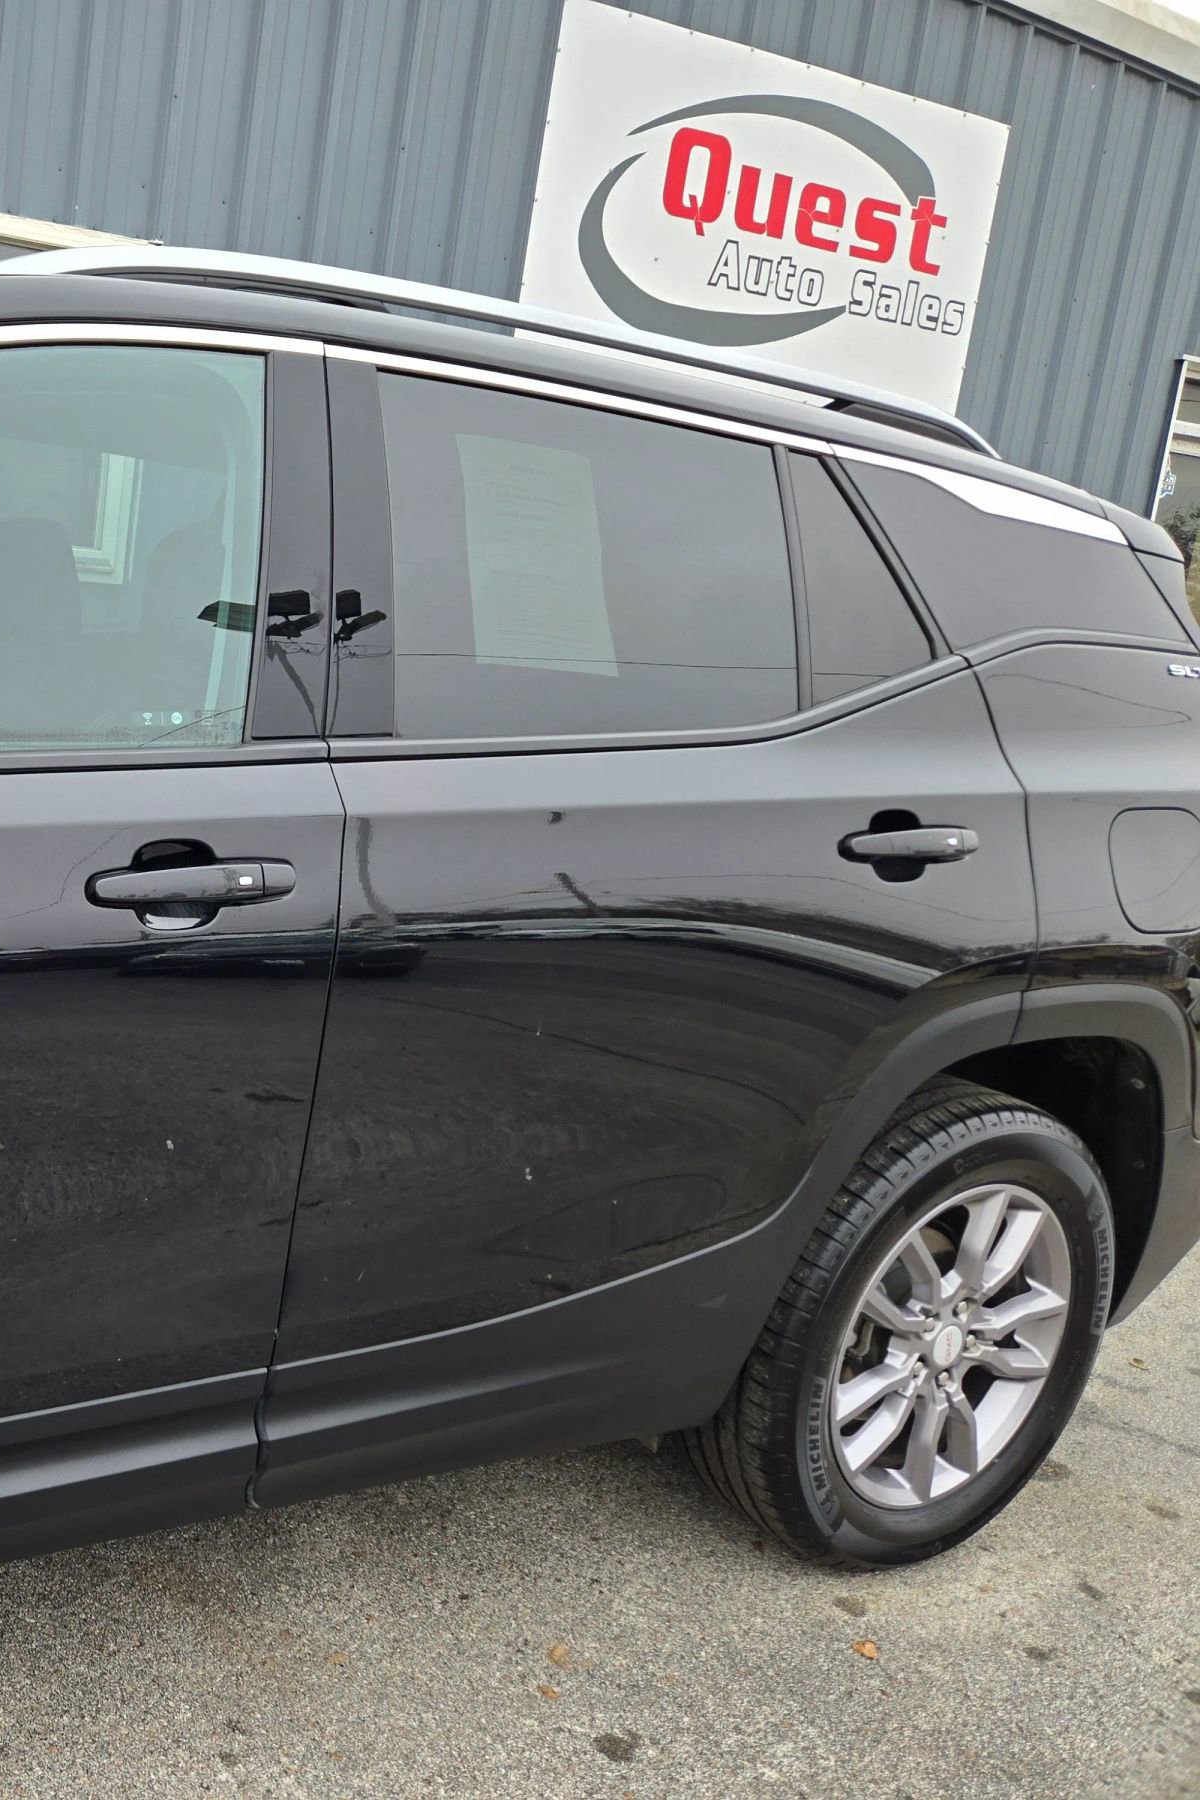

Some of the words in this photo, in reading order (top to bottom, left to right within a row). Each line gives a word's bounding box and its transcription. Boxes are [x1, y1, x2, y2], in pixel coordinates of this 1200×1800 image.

[663, 127, 948, 276] Quest
[707, 239, 824, 306] Auto
[848, 269, 966, 336] Sales
[1094, 1228, 1110, 1329] MICHELIN
[809, 1383, 827, 1491] MICHELIN
